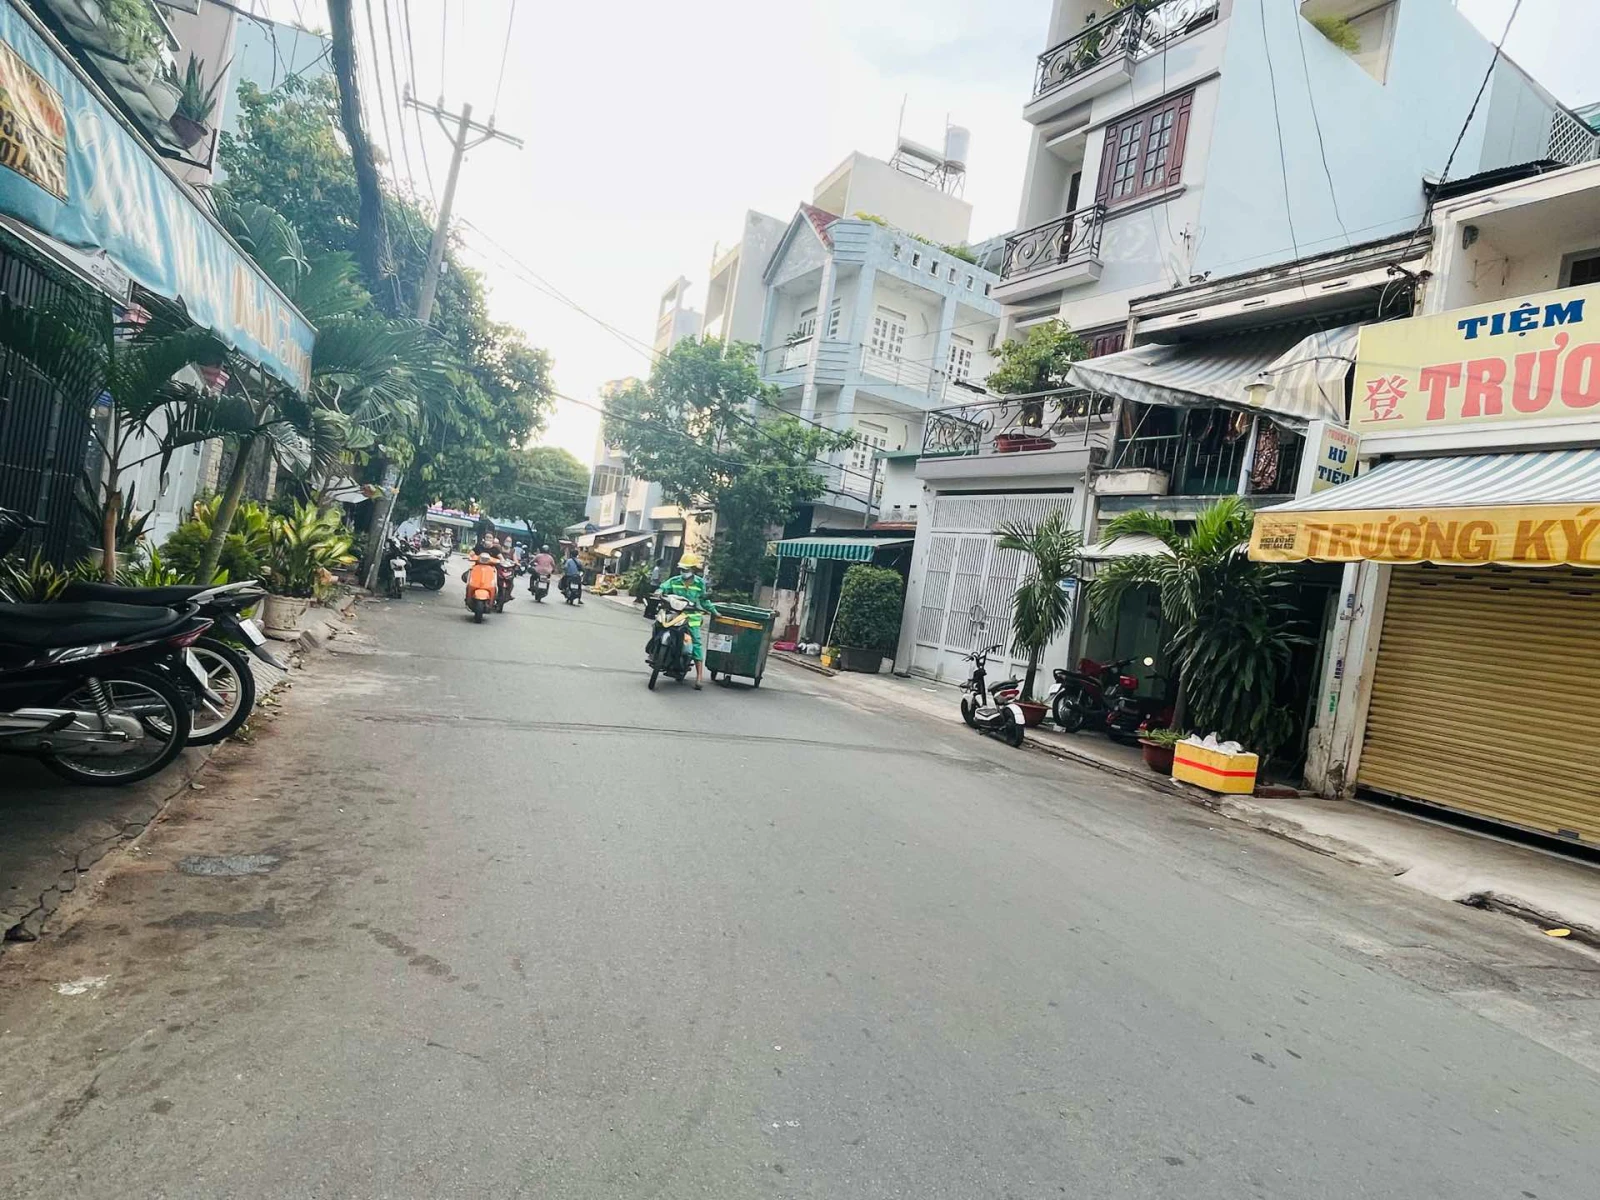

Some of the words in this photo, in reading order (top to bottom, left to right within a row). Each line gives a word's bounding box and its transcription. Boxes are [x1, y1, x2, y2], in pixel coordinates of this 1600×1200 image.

[1457, 299, 1586, 340] TIỆM
[1360, 375, 1410, 423] 登
[1328, 444, 1348, 464] HỦ
[1304, 515, 1495, 561] TRƯƠNG
[1512, 507, 1600, 561] KÝ
